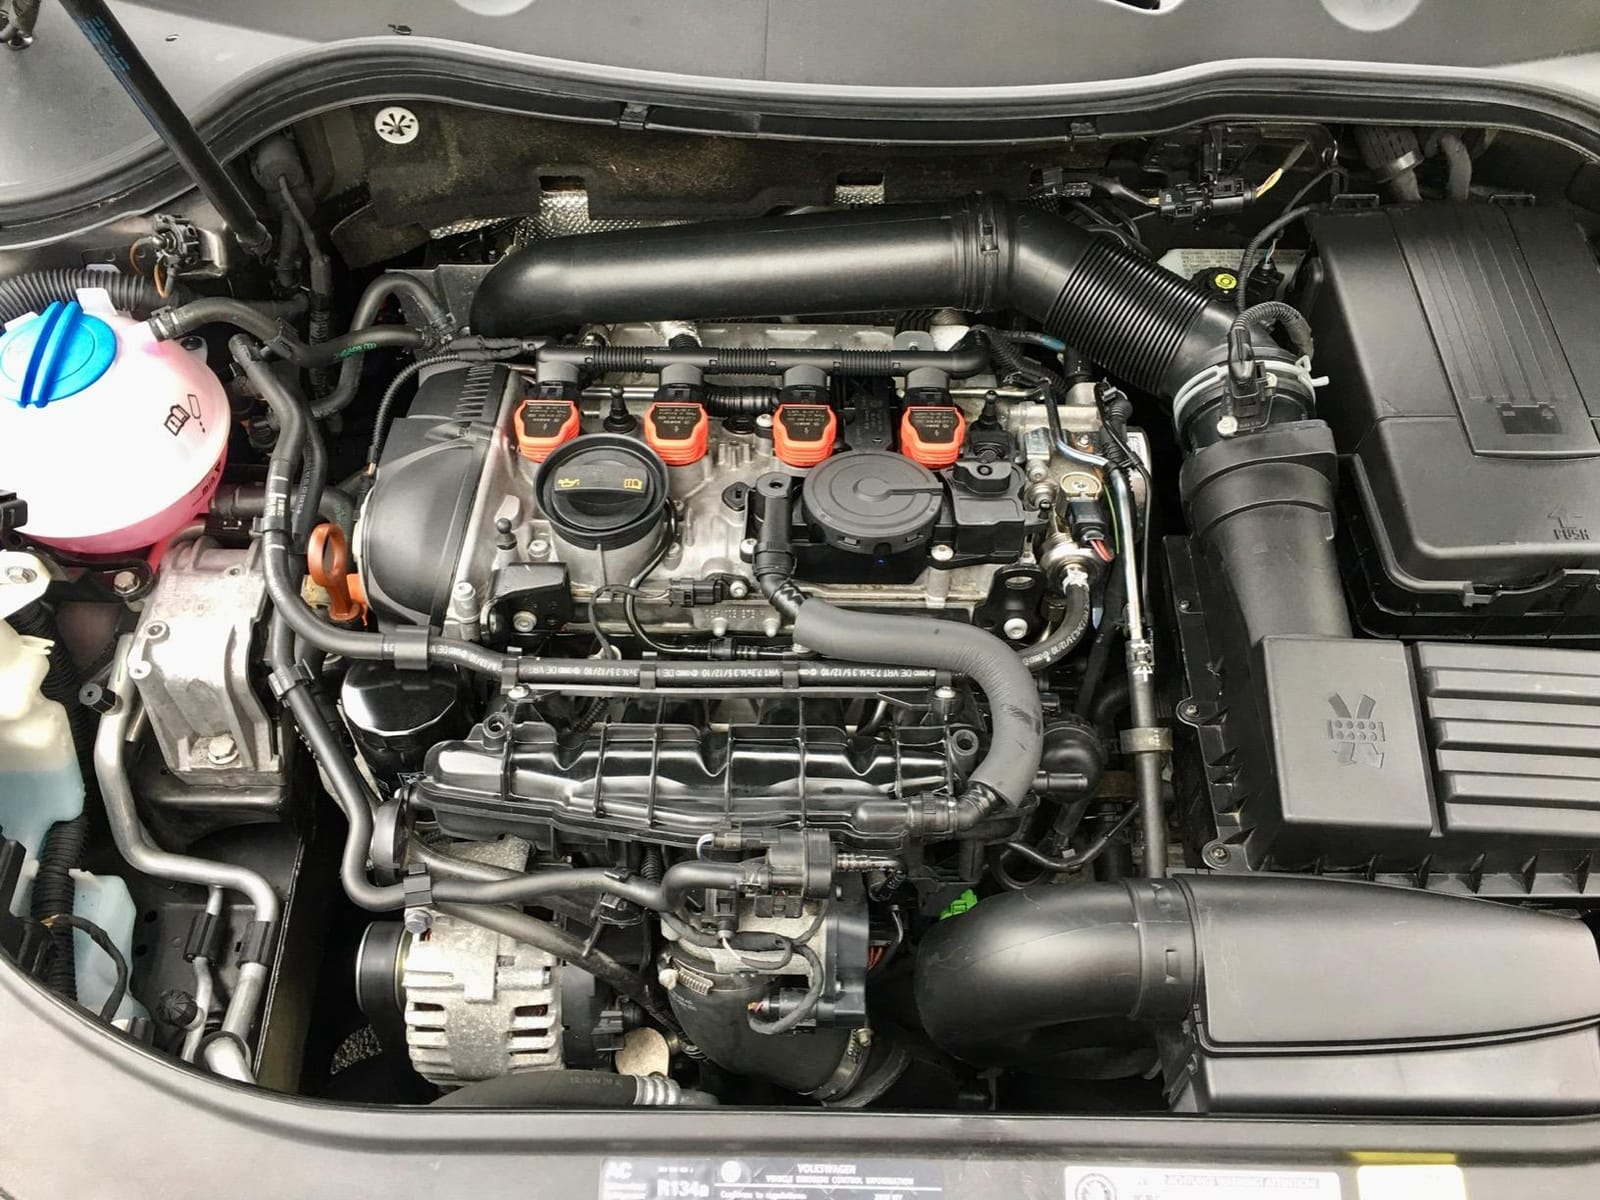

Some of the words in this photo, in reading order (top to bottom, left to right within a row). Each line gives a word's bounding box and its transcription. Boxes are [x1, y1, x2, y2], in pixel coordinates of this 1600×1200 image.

[663, 669, 675, 678] DE
[702, 668, 733, 677] 5/12/10
[764, 668, 780, 677] VRT
[883, 669, 900, 678] VRT
[900, 669, 912, 678] DE
[605, 1161, 633, 1180] AC
[797, 1163, 857, 1175] VOLKSWAGEN
[832, 1175, 863, 1185] CONTROL
[657, 1179, 709, 1198] R134a
